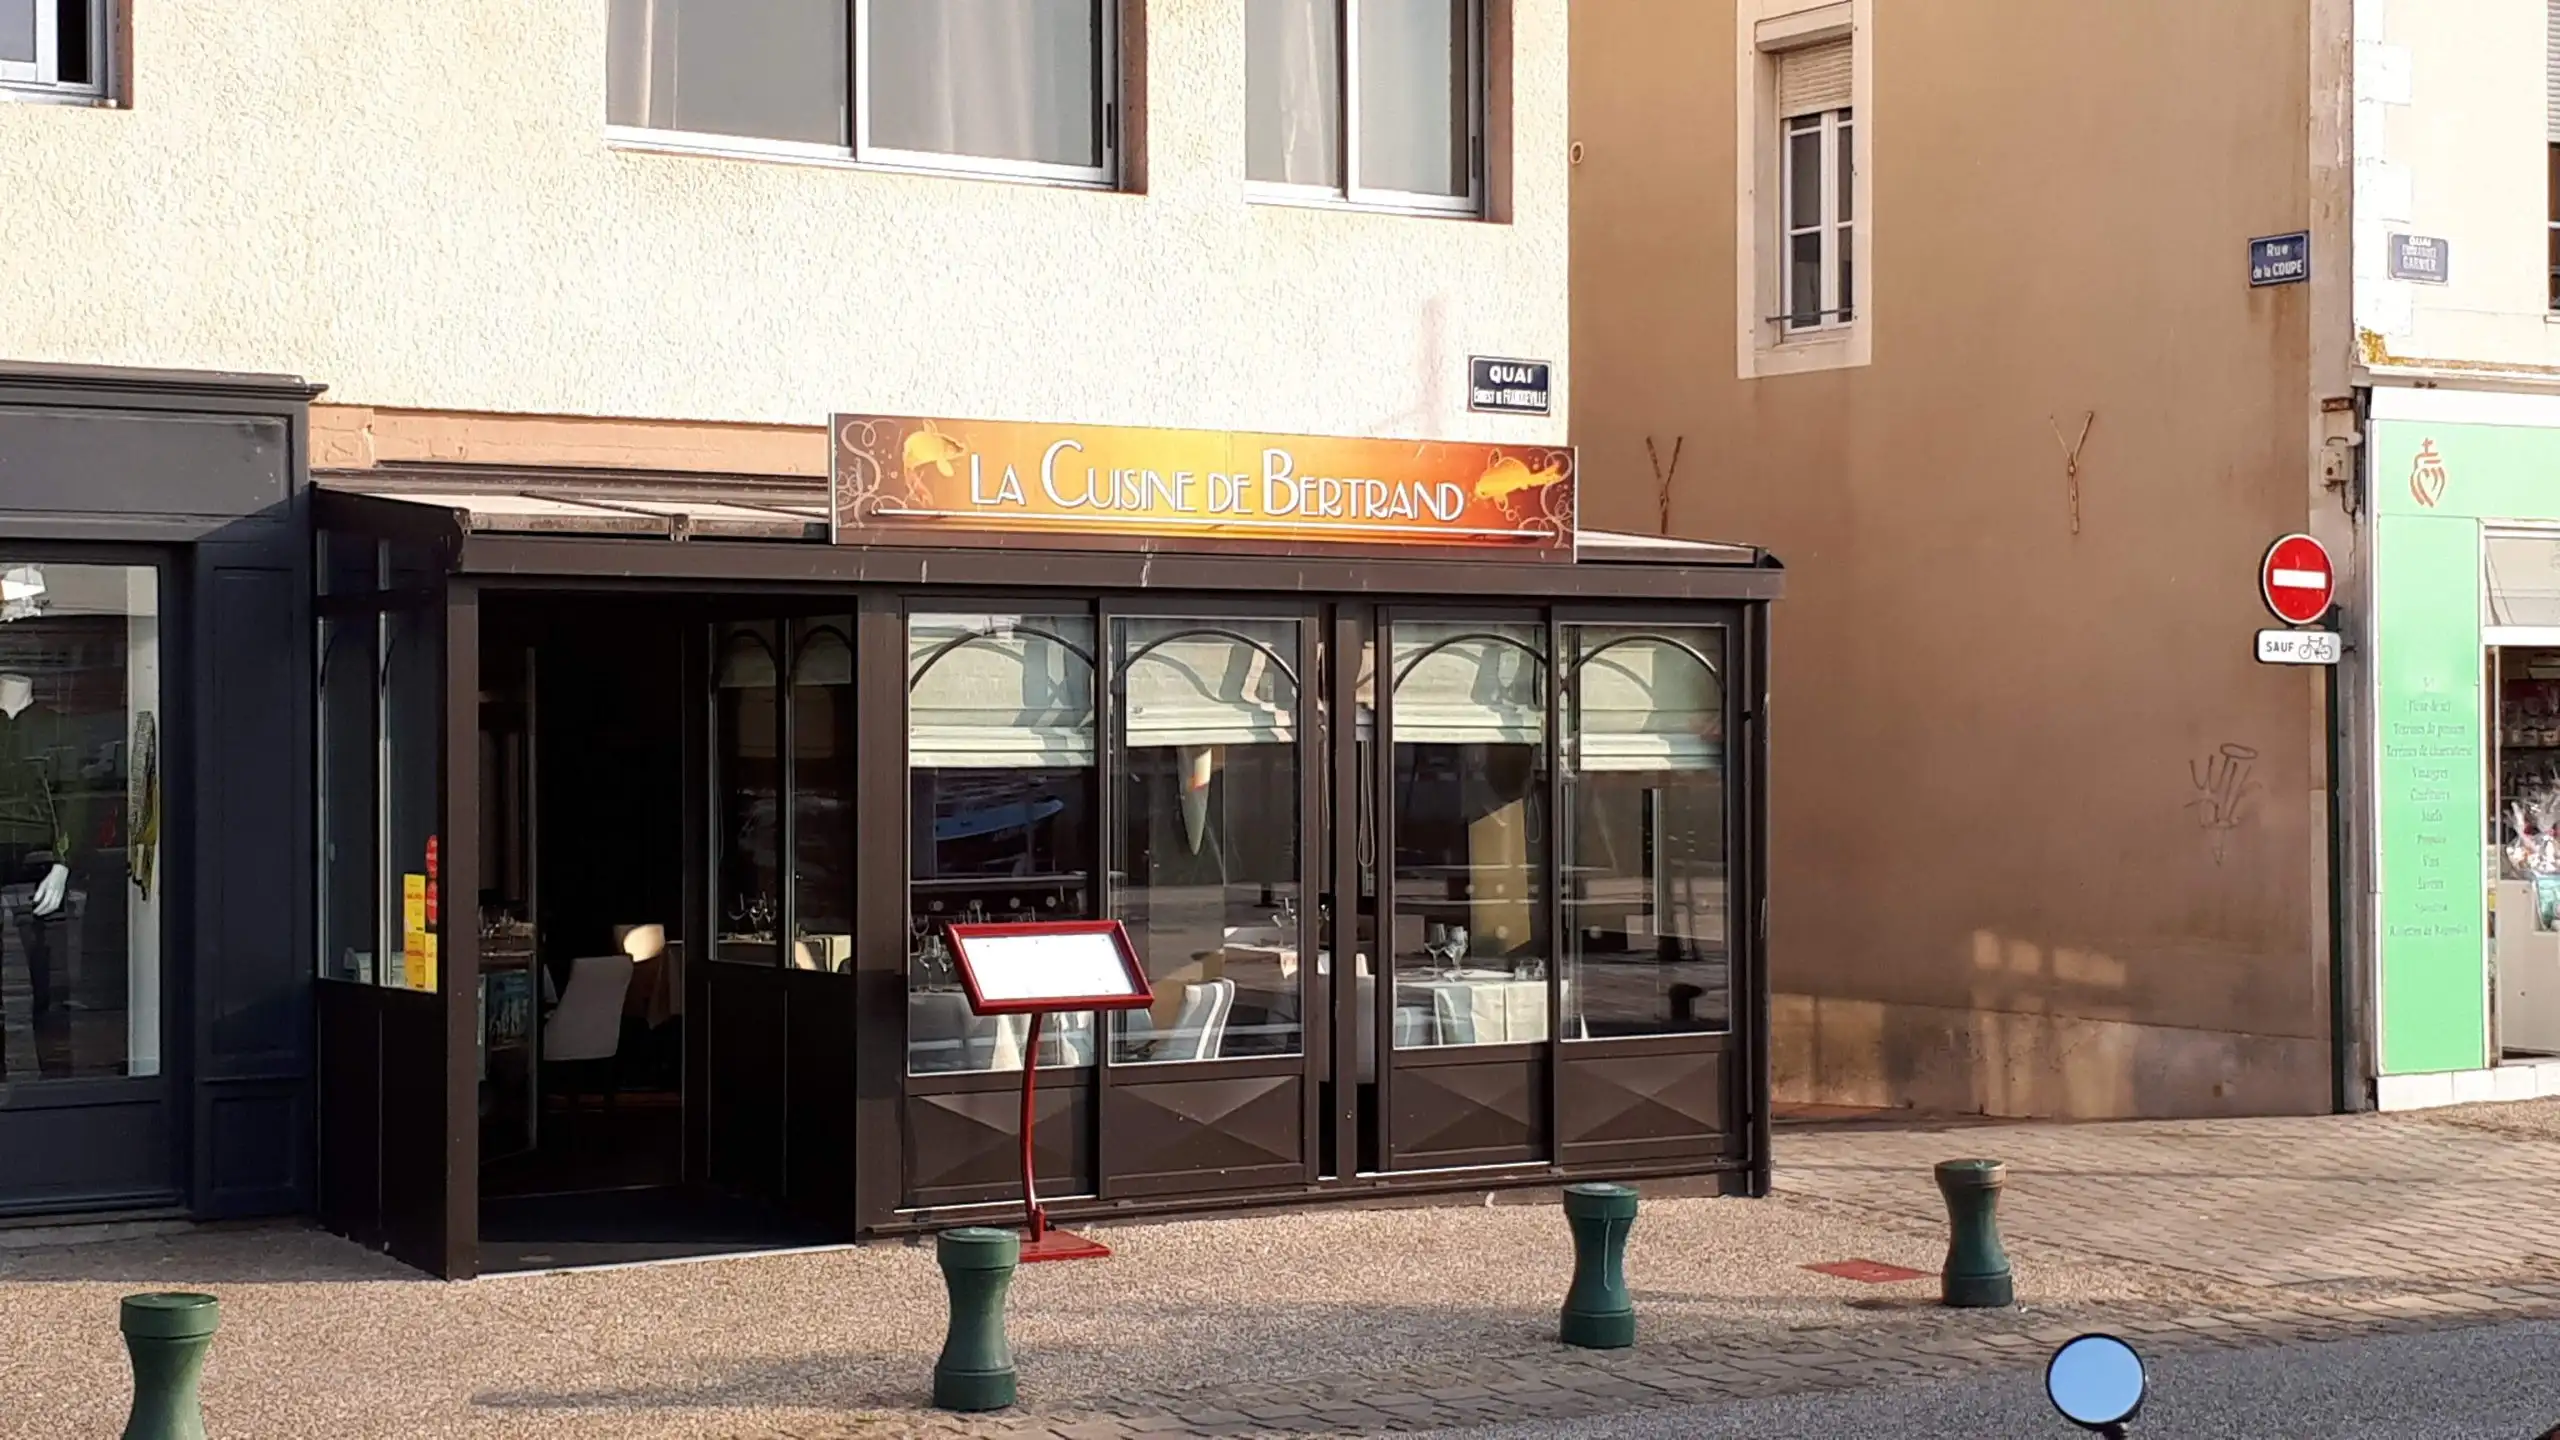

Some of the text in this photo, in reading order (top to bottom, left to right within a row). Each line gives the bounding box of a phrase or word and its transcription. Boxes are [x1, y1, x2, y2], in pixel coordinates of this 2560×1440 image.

[2266, 243, 2289, 256] Rue
[2272, 259, 2302, 276] COUPE
[1489, 365, 1533, 389] QUAI
[970, 452, 1026, 506] LA
[1207, 472, 1253, 514] DE
[1262, 448, 1466, 521] BERTRAND
[2265, 641, 2295, 653] SAUF
